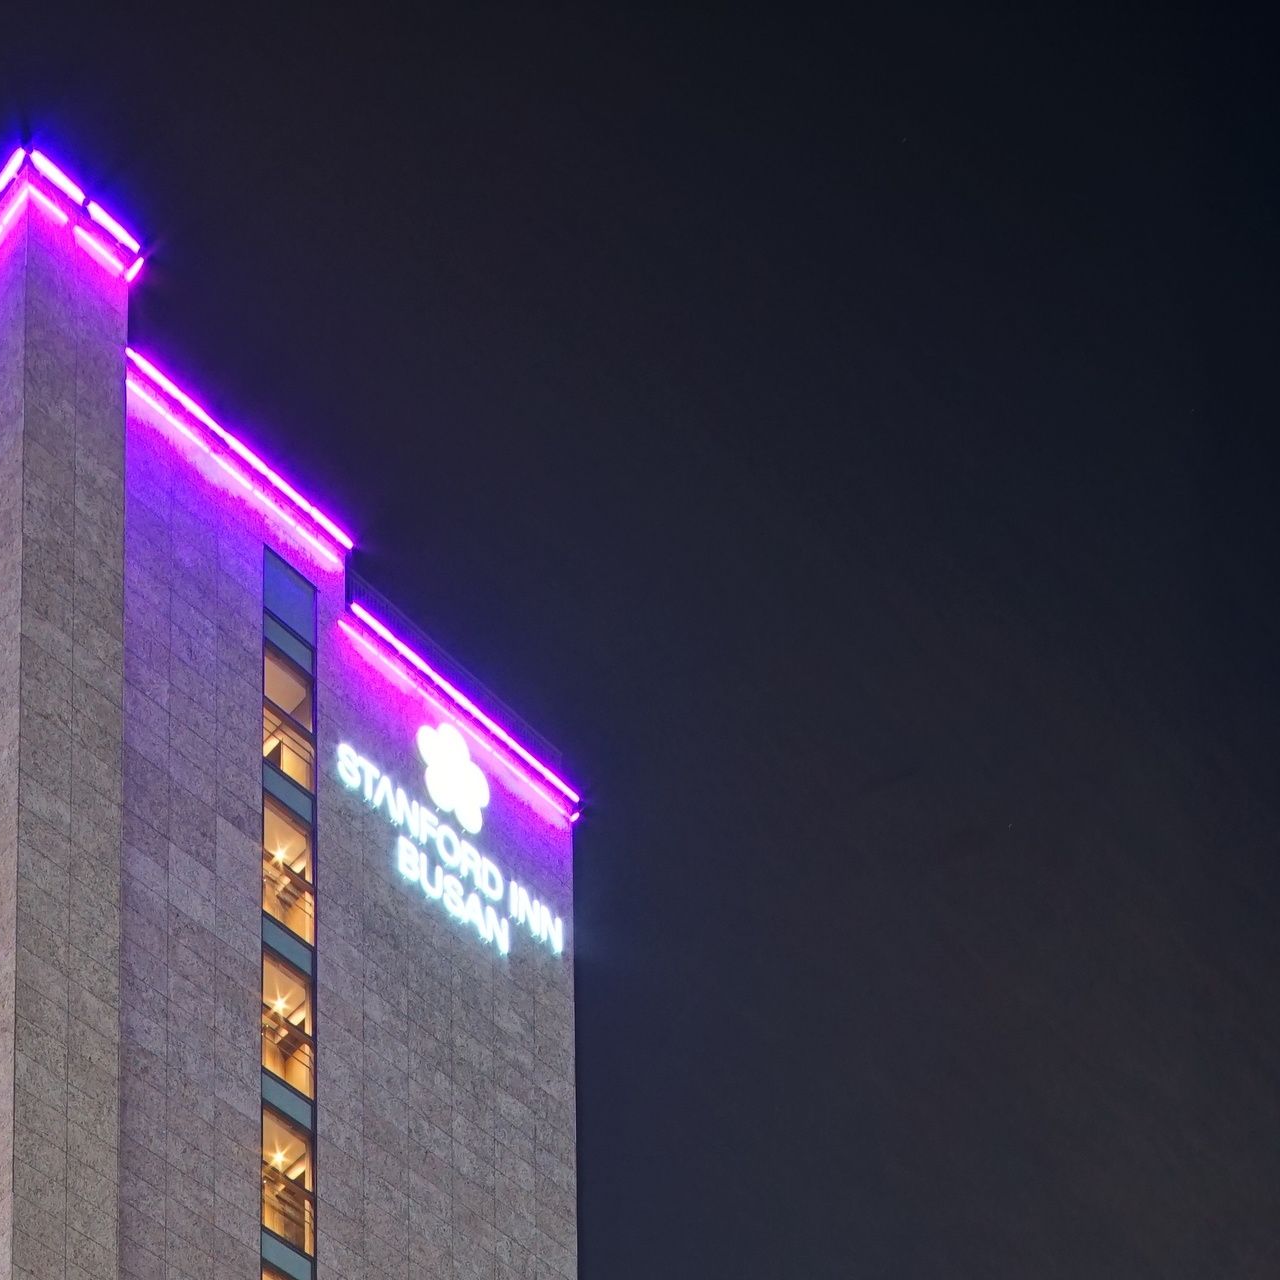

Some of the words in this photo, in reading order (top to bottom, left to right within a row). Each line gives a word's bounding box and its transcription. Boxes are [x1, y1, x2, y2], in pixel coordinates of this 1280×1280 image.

[336, 742, 504, 902] STANFORD
[509, 880, 563, 955] INN
[397, 835, 509, 955] BUSAN
